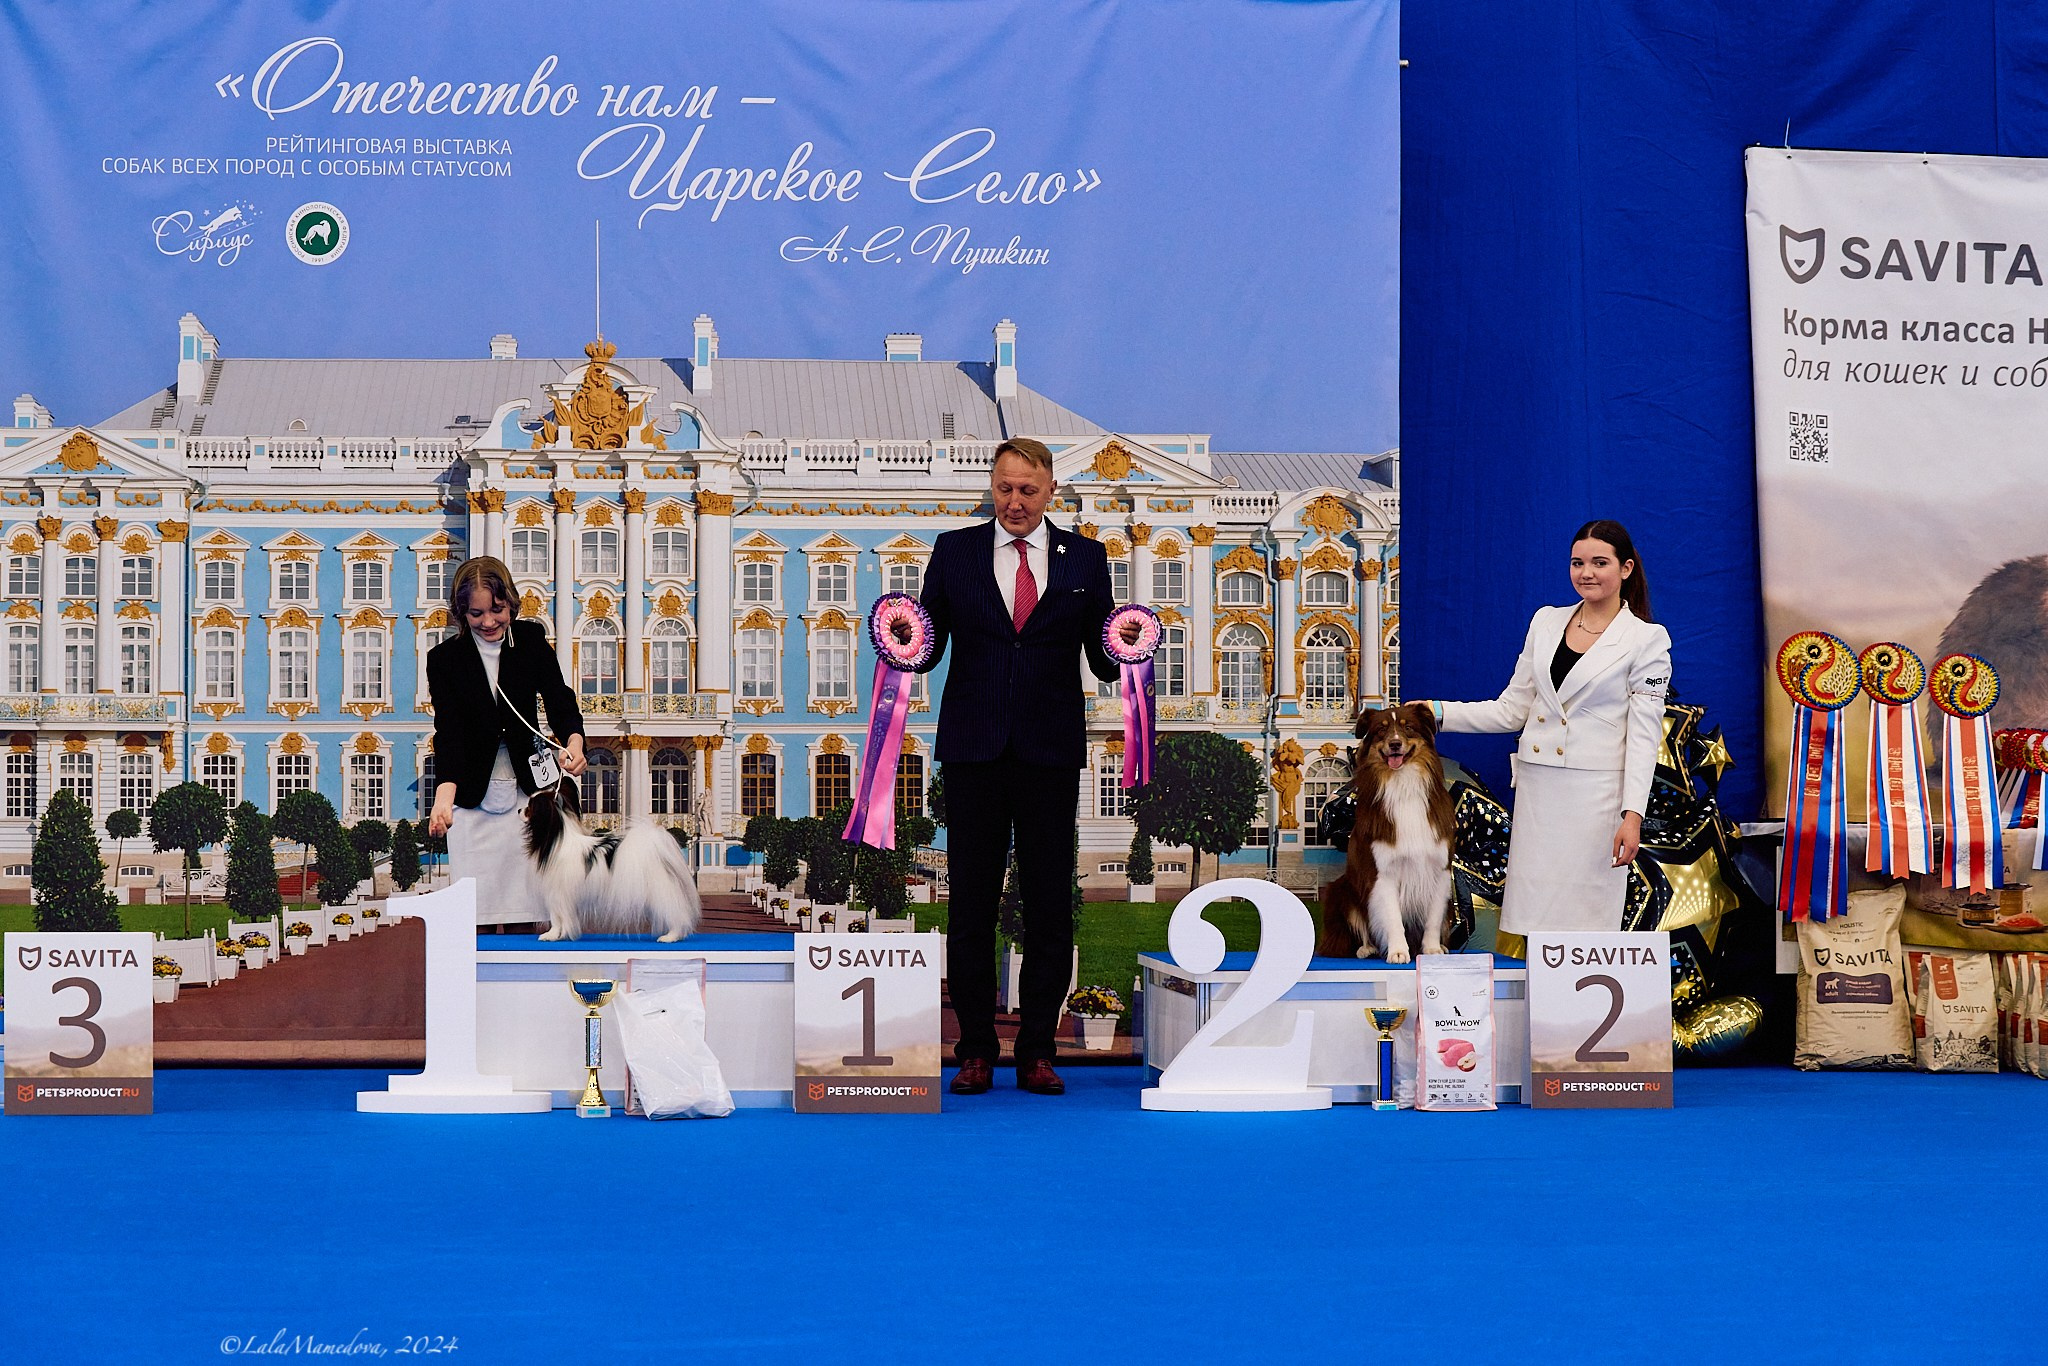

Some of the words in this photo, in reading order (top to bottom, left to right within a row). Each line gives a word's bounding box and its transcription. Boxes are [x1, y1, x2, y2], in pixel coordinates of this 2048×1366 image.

[215, 36, 580, 121] «Отечество
[597, 83, 714, 119] нам
[265, 134, 408, 155] РЕЙТИНГОВАЯ
[413, 137, 513, 155] ВЫСТАВКА
[101, 157, 166, 175] СОБАК
[171, 158, 220, 175] ВСЕХ
[224, 158, 296, 179] ПОРОД
[300, 159, 313, 176] С
[317, 159, 406, 177] ОСОБЫМ
[411, 160, 513, 177] СТАТУСОМ
[576, 122, 863, 230] Царское
[883, 127, 1103, 205] Село»
[151, 210, 254, 267] Сириус
[910, 223, 1050, 274] Пушкин
[1839, 236, 2044, 286] SAVITA
[1783, 307, 1889, 345] Корма
[1901, 319, 2015, 344] класса
[1783, 348, 1831, 382] для
[1845, 361, 1948, 386] кошек
[1961, 365, 1979, 387] и
[1839, 921, 1864, 929] HOLISTIC
[48, 949, 139, 968] SAVITA
[838, 949, 927, 968] SAVITA
[1571, 947, 1658, 966] SAVITA
[1834, 948, 1894, 967] SAVITA
[386, 876, 513, 1093] 1
[1158, 877, 1316, 1092] 2
[49, 976, 107, 1069] 3
[841, 976, 894, 1066] 1
[1435, 1019, 1458, 1027] BOWL
[1459, 1019, 1481, 1027] WOW
[1575, 974, 1630, 1063] 2
[1953, 1005, 1988, 1014] SAVITA
[36, 1086, 140, 1098] PETSPRODUCTRU
[827, 1086, 928, 1096] PETSPRODUCTRU
[1563, 1082, 1661, 1092] PETSPRODUCTRU
